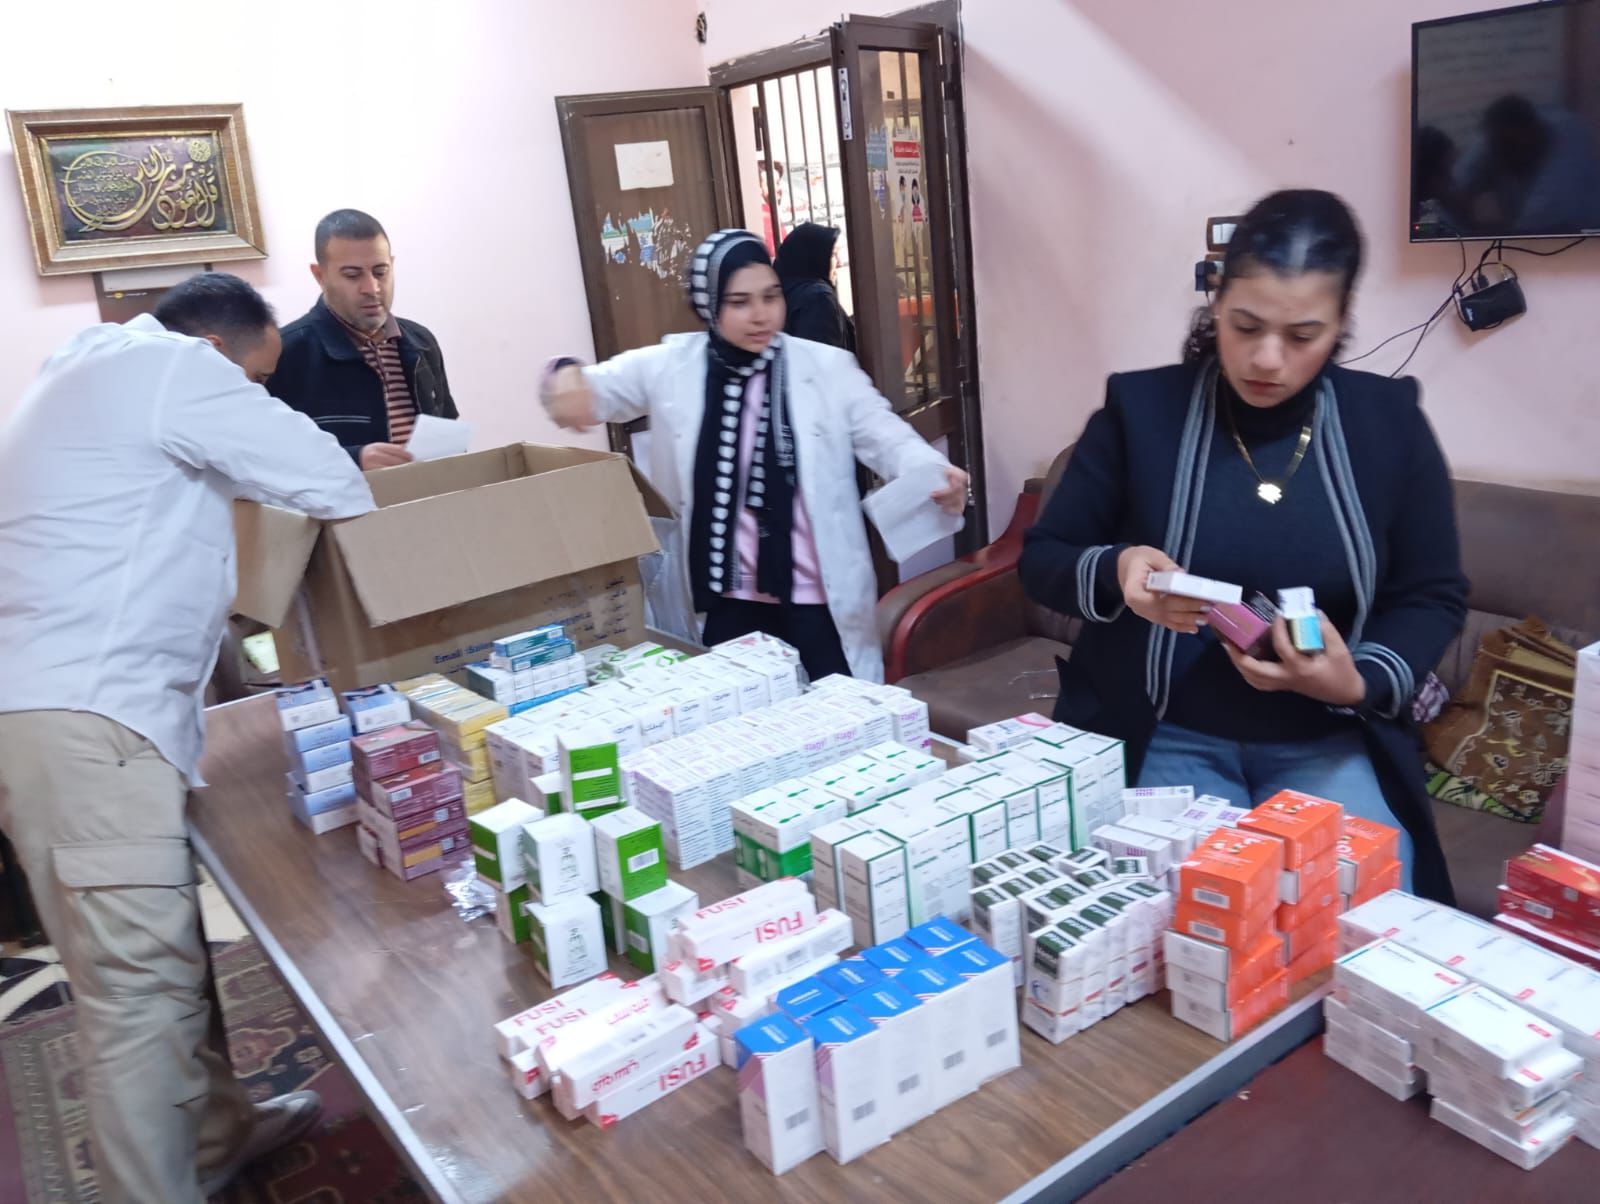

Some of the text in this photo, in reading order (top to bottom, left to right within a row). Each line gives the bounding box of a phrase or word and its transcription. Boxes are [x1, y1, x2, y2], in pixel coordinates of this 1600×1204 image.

[694, 897, 747, 919] FUSI
[755, 910, 804, 943] FUSI
[512, 999, 566, 1027] FUSI
[535, 1008, 588, 1035] FUSI
[658, 1053, 707, 1091] FUSI
